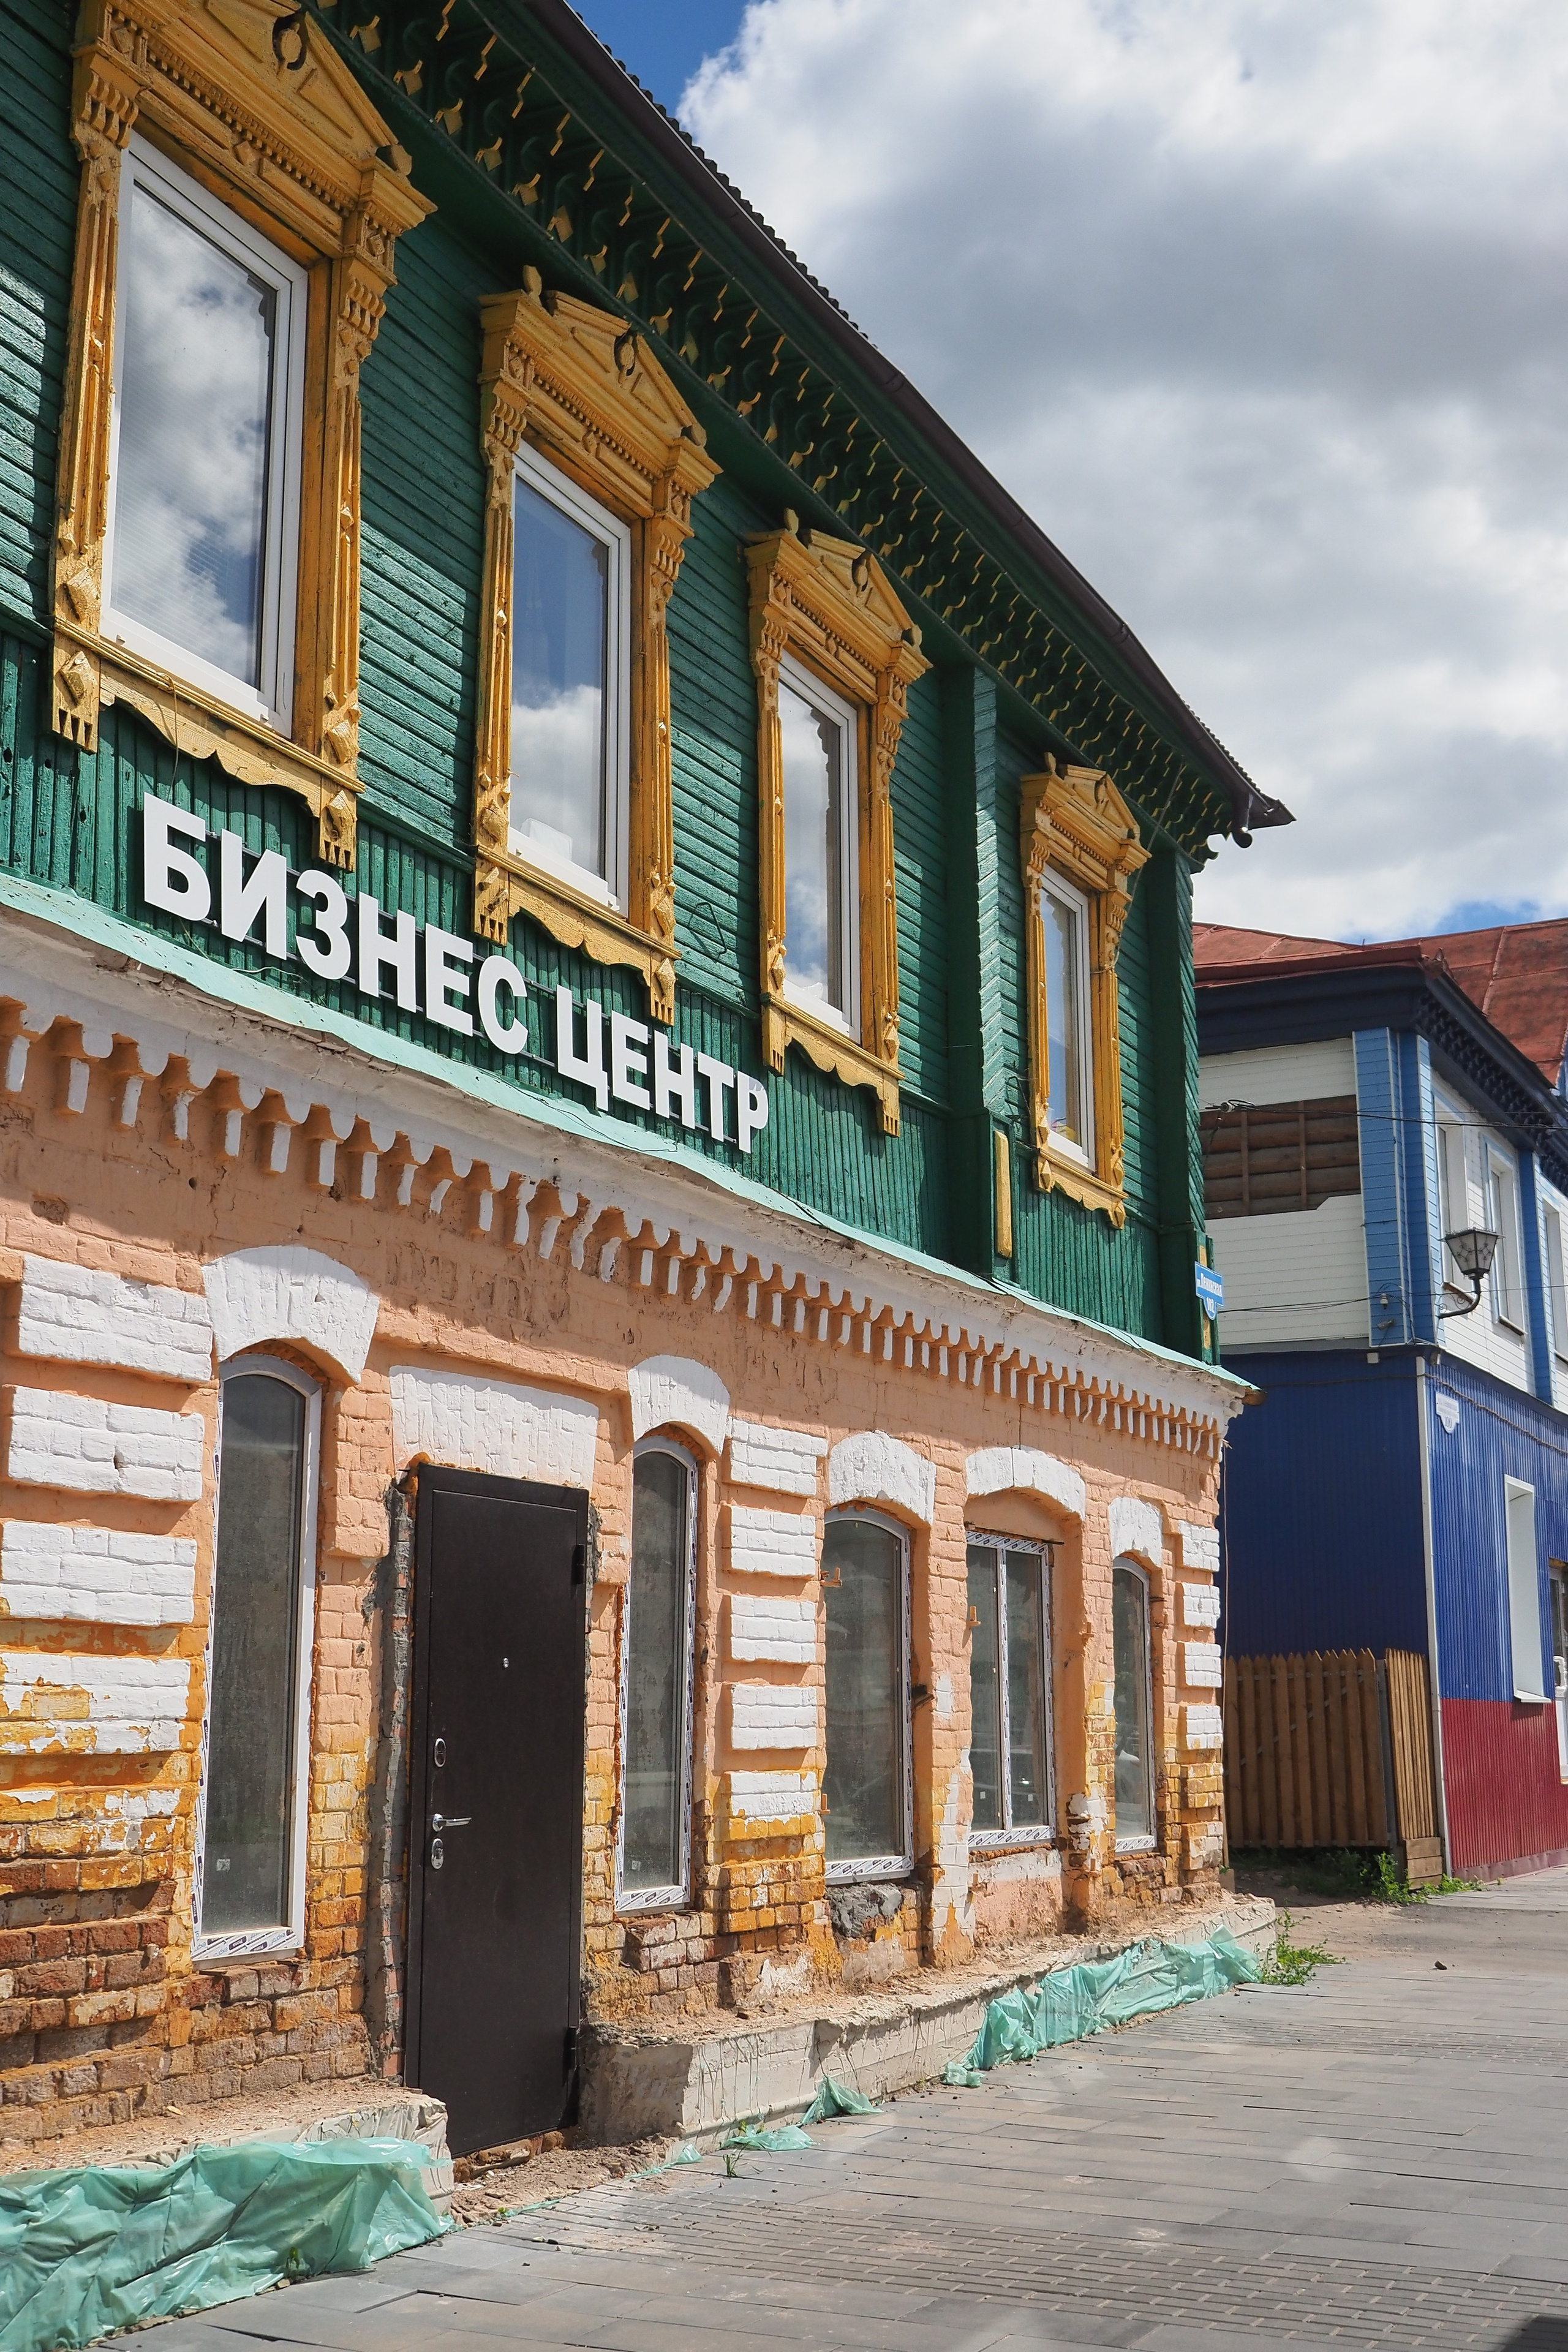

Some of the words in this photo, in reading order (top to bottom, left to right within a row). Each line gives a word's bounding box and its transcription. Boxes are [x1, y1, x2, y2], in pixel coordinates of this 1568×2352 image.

[143, 792, 529, 1054] БИЗНЕС
[556, 984, 769, 1153] ЦЕНТР
[1206, 1296, 1215, 1314] 102
